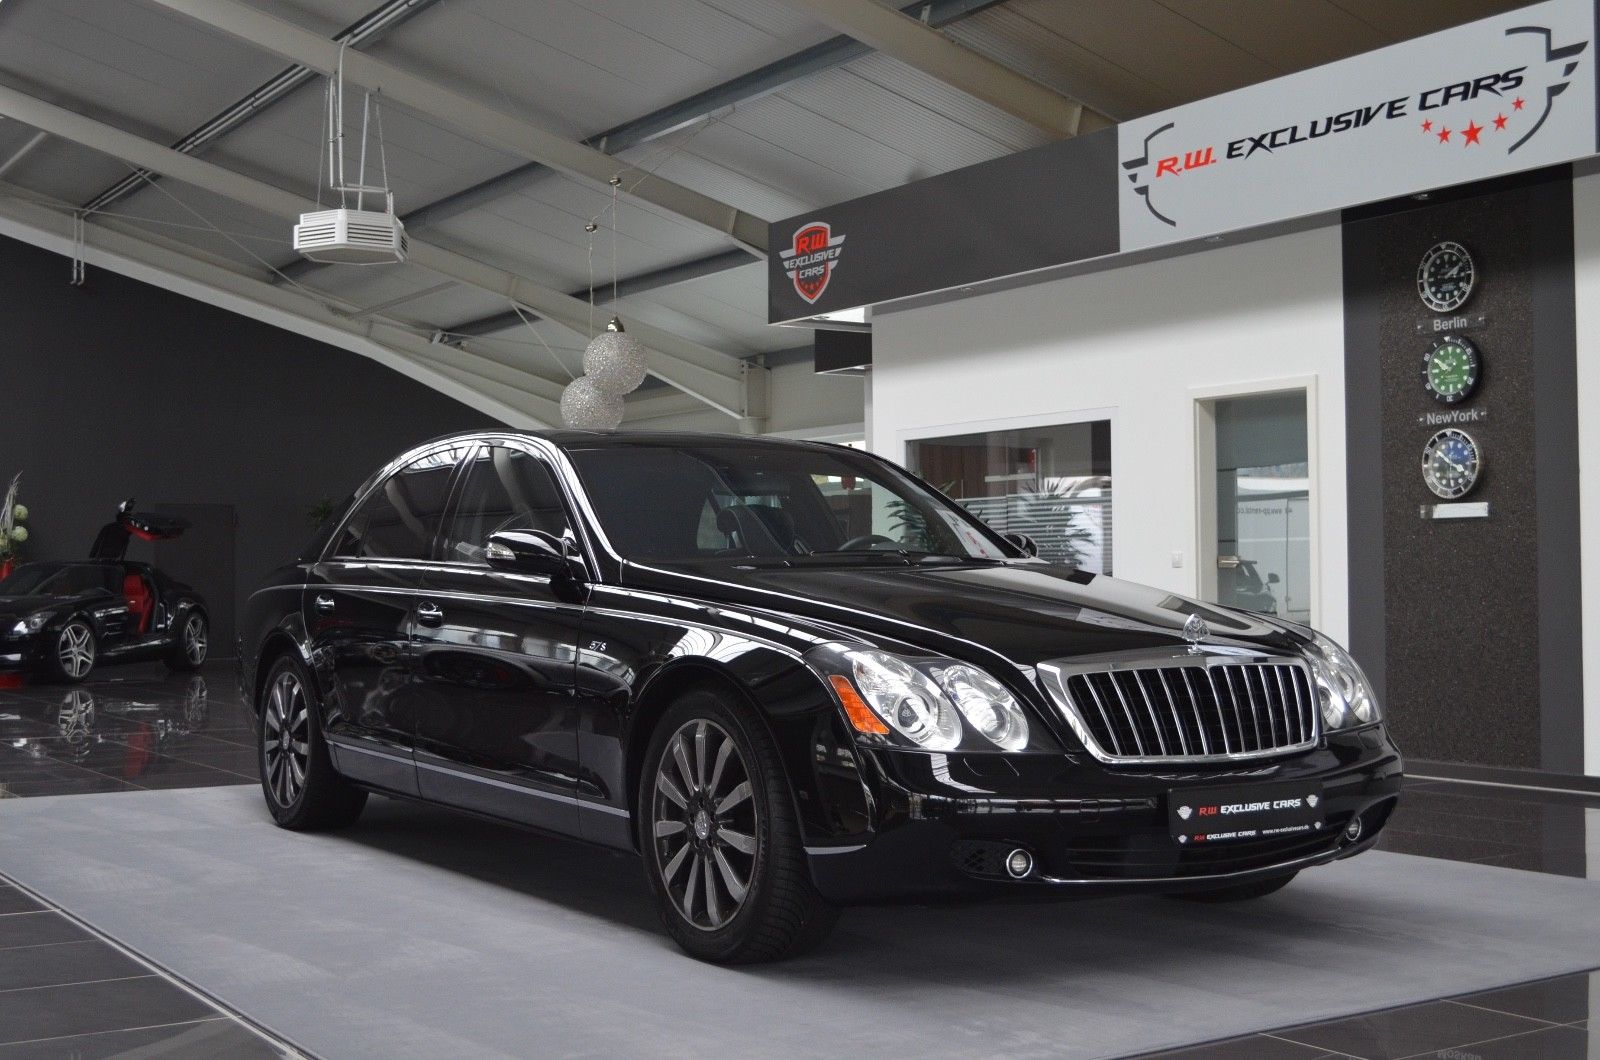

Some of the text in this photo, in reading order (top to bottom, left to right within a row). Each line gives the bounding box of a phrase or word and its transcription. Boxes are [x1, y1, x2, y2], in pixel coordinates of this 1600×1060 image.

[1155, 66, 1529, 178] R.W. EXCLUSIVE CARS
[789, 249, 834, 268] EXCLUSIVE
[799, 265, 825, 279] CARS
[1433, 317, 1467, 331] Berlin
[1220, 801, 1270, 815] EXCLUSIVE
[1273, 798, 1301, 809] CARS
[1206, 831, 1236, 840] EXCLUSIVE
[1238, 829, 1256, 837] CARS
